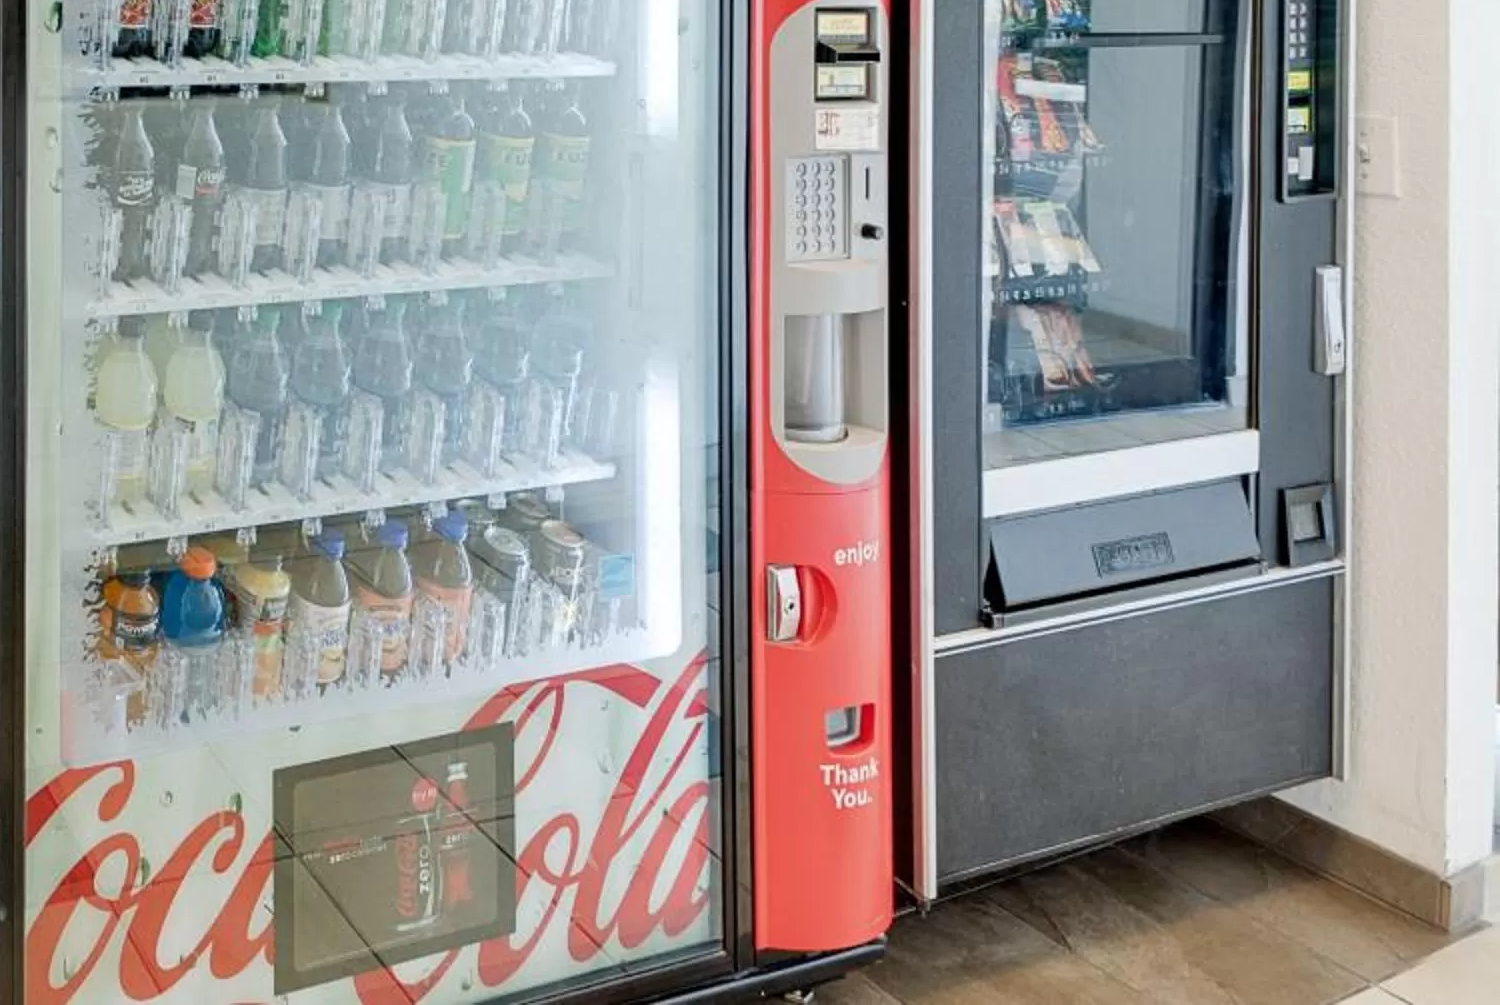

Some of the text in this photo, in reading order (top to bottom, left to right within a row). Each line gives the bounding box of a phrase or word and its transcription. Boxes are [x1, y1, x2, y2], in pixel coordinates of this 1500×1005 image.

[834, 540, 879, 567] enjoy
[820, 756, 879, 786] Thank
[832, 787, 874, 810] You.
